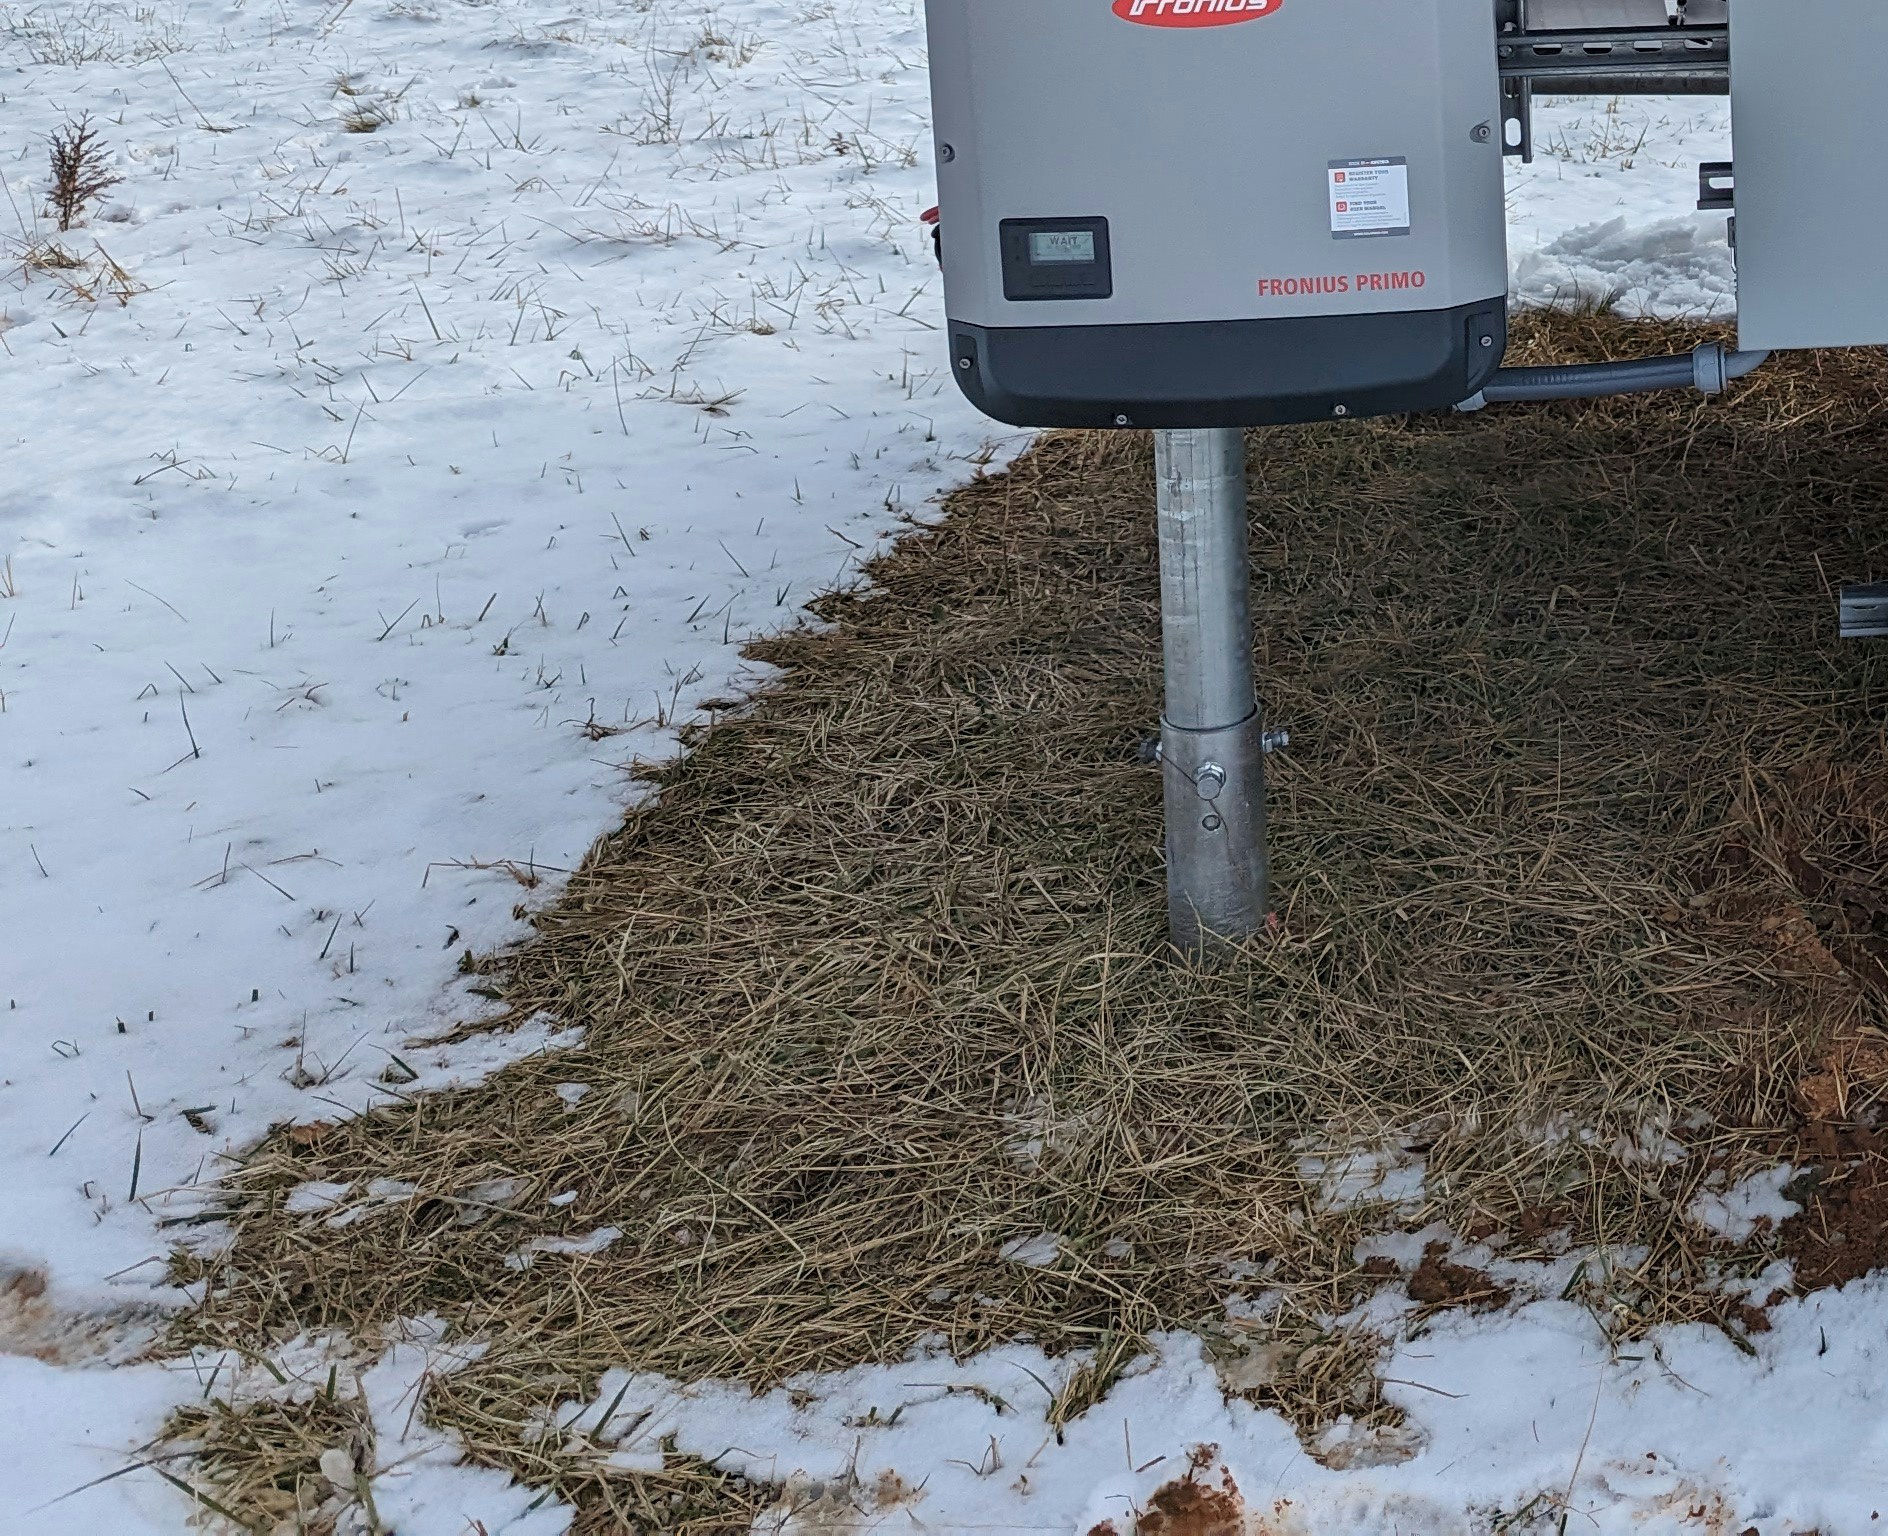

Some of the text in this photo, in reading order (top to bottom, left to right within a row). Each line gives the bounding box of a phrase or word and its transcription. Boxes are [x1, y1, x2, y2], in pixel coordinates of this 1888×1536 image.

[1049, 235, 1078, 246] WAIT
[1257, 270, 1426, 297] FRONIUS PRIMO
